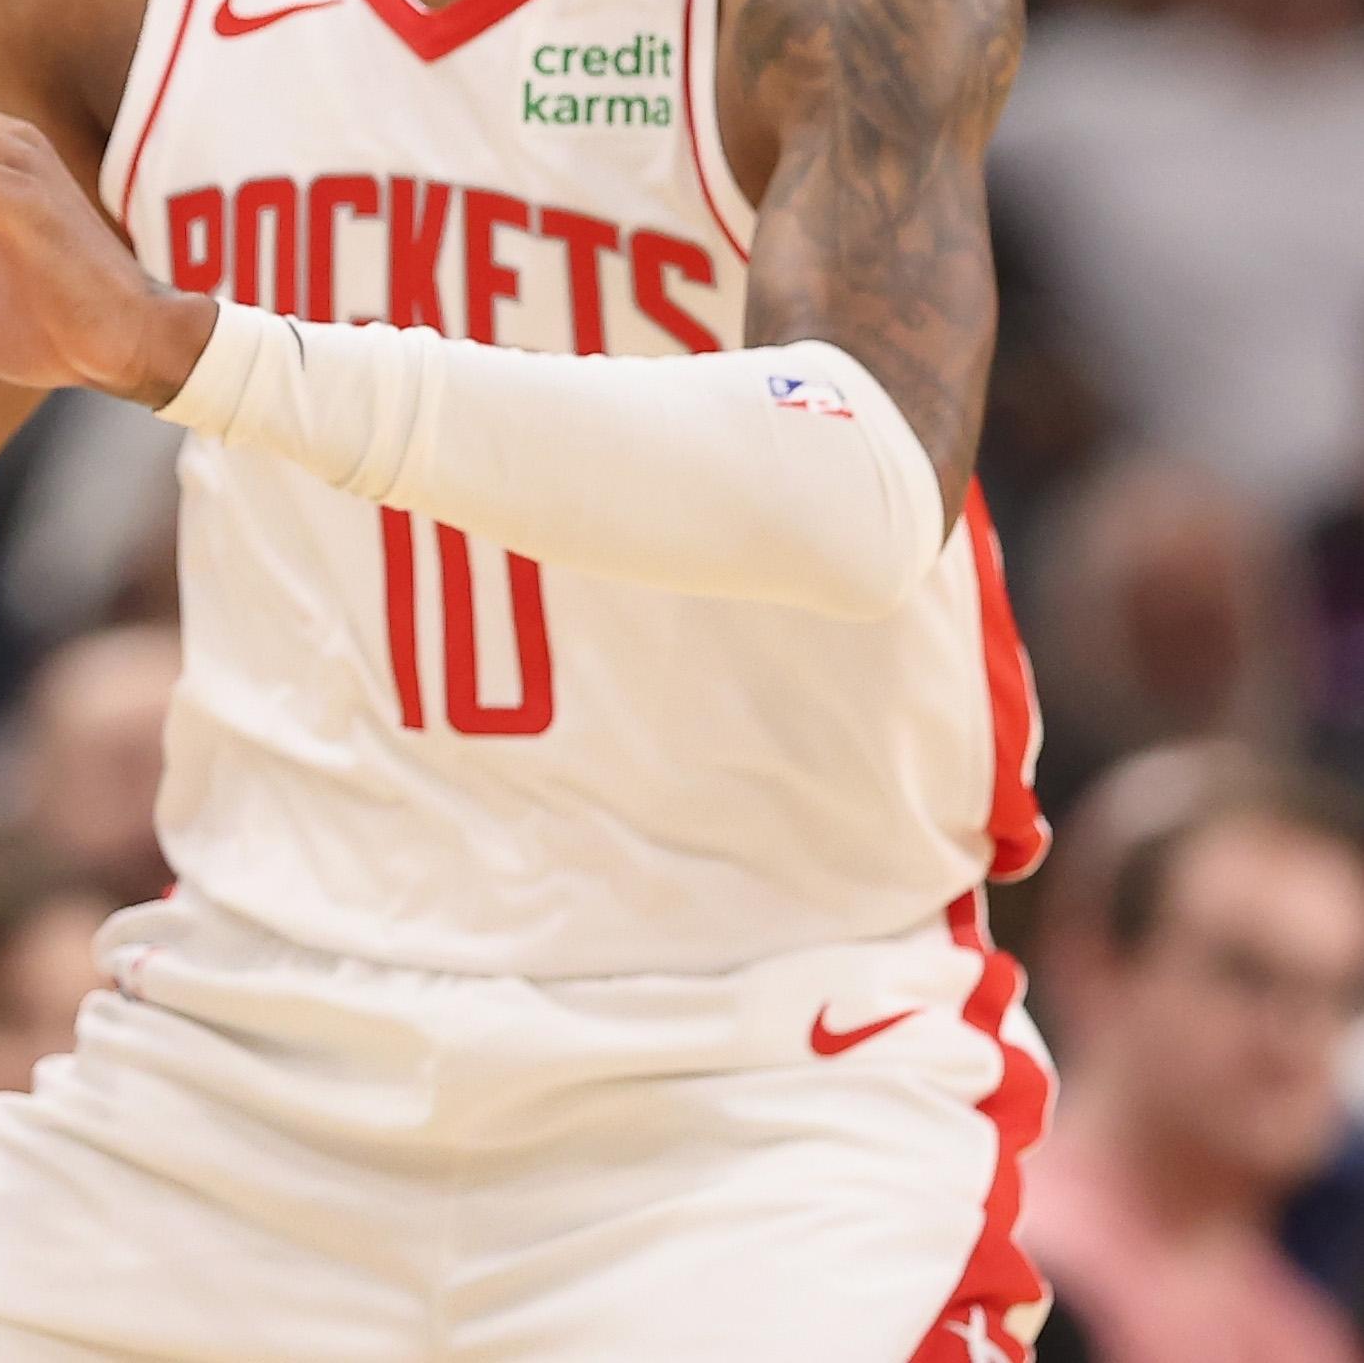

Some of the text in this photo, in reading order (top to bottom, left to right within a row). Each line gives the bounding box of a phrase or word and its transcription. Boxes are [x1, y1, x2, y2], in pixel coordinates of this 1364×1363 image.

[532, 33, 672, 77] credit
[523, 79, 671, 127] karma
[378, 503, 554, 736] 10
